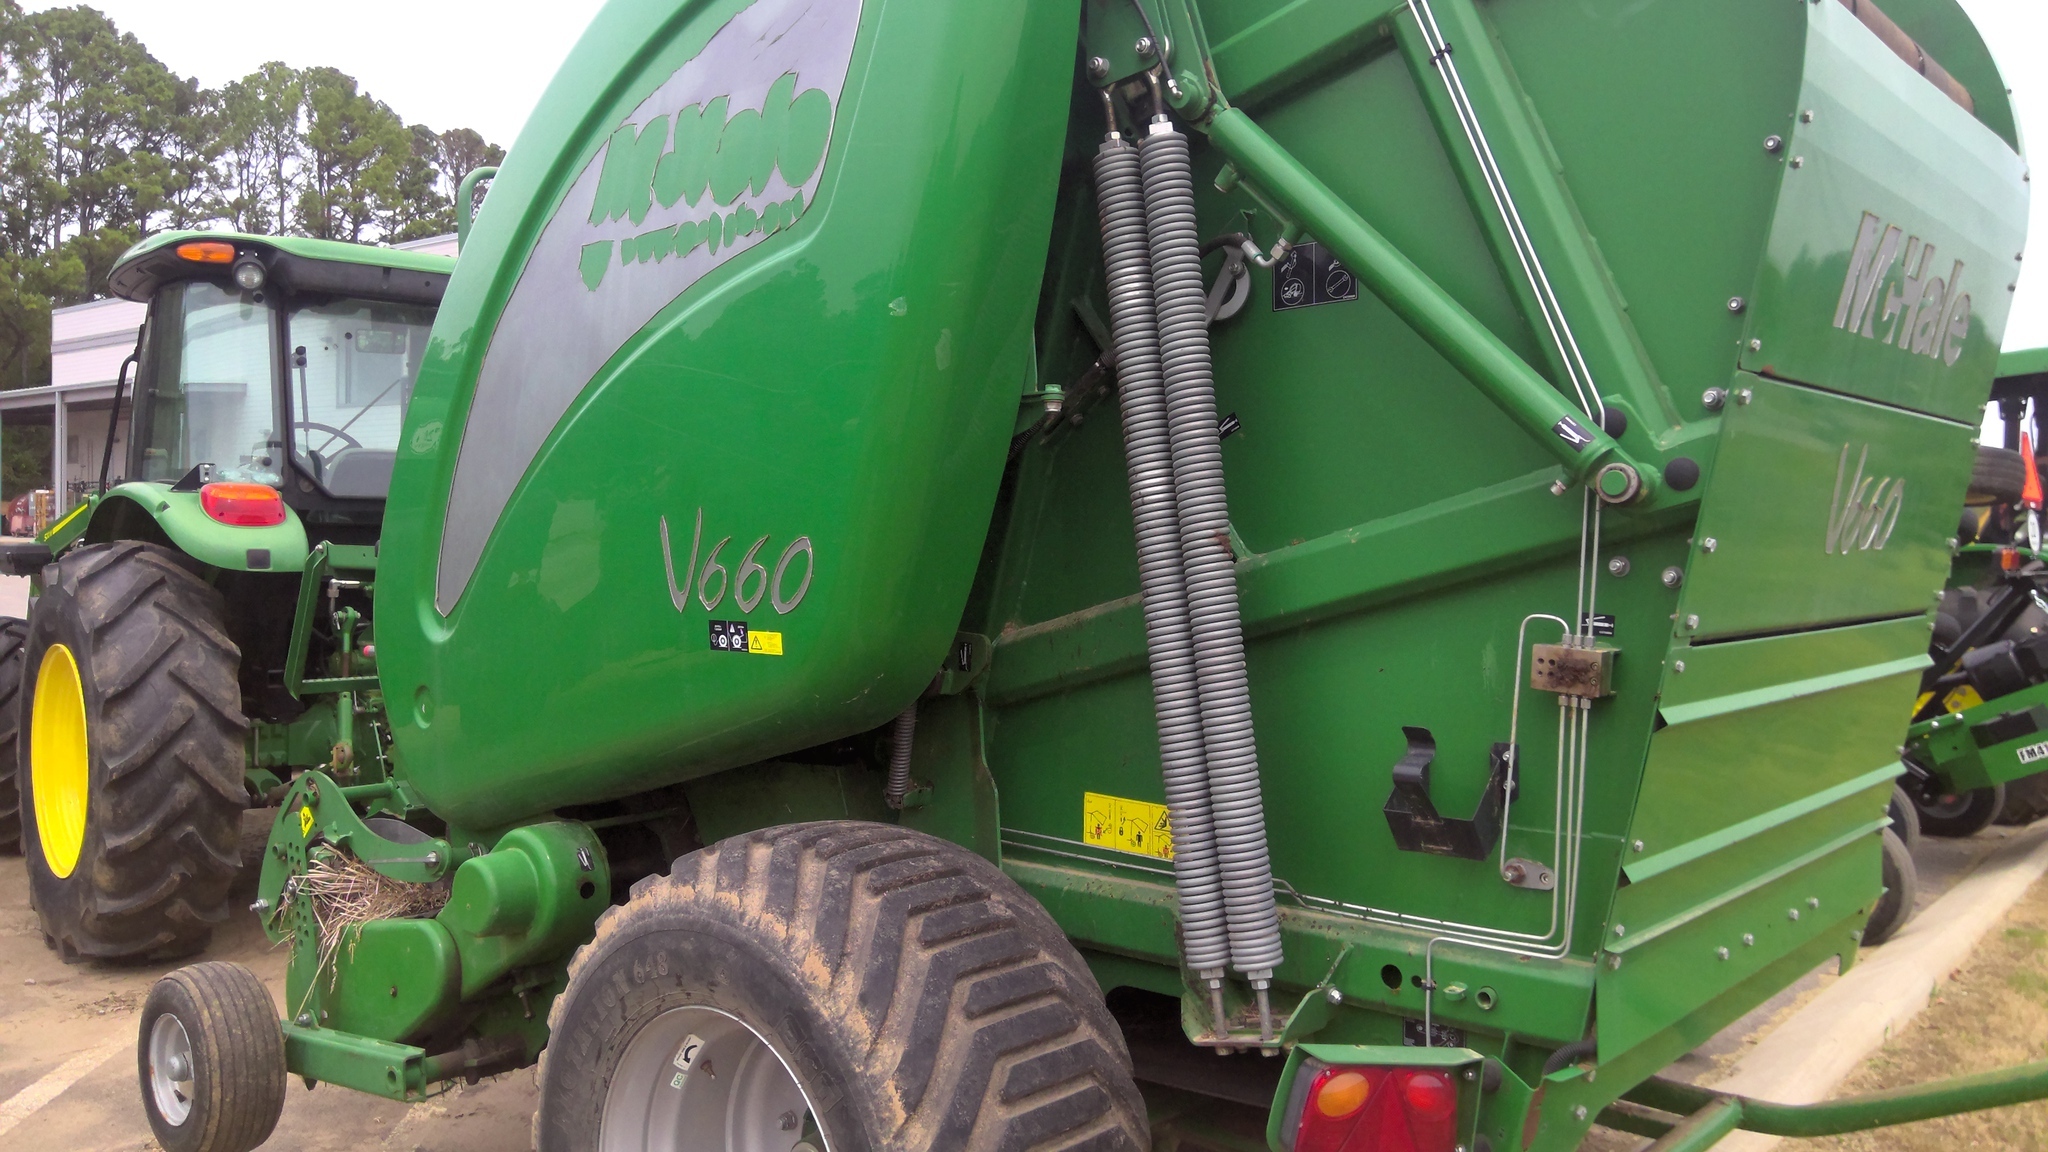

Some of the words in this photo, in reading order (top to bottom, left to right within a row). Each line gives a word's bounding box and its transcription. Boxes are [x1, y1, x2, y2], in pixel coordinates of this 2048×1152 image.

[1833, 210, 1971, 367] McHale
[1825, 442, 1905, 555] V660
[660, 506, 814, 615] V660
[633, 951, 669, 984] 648
